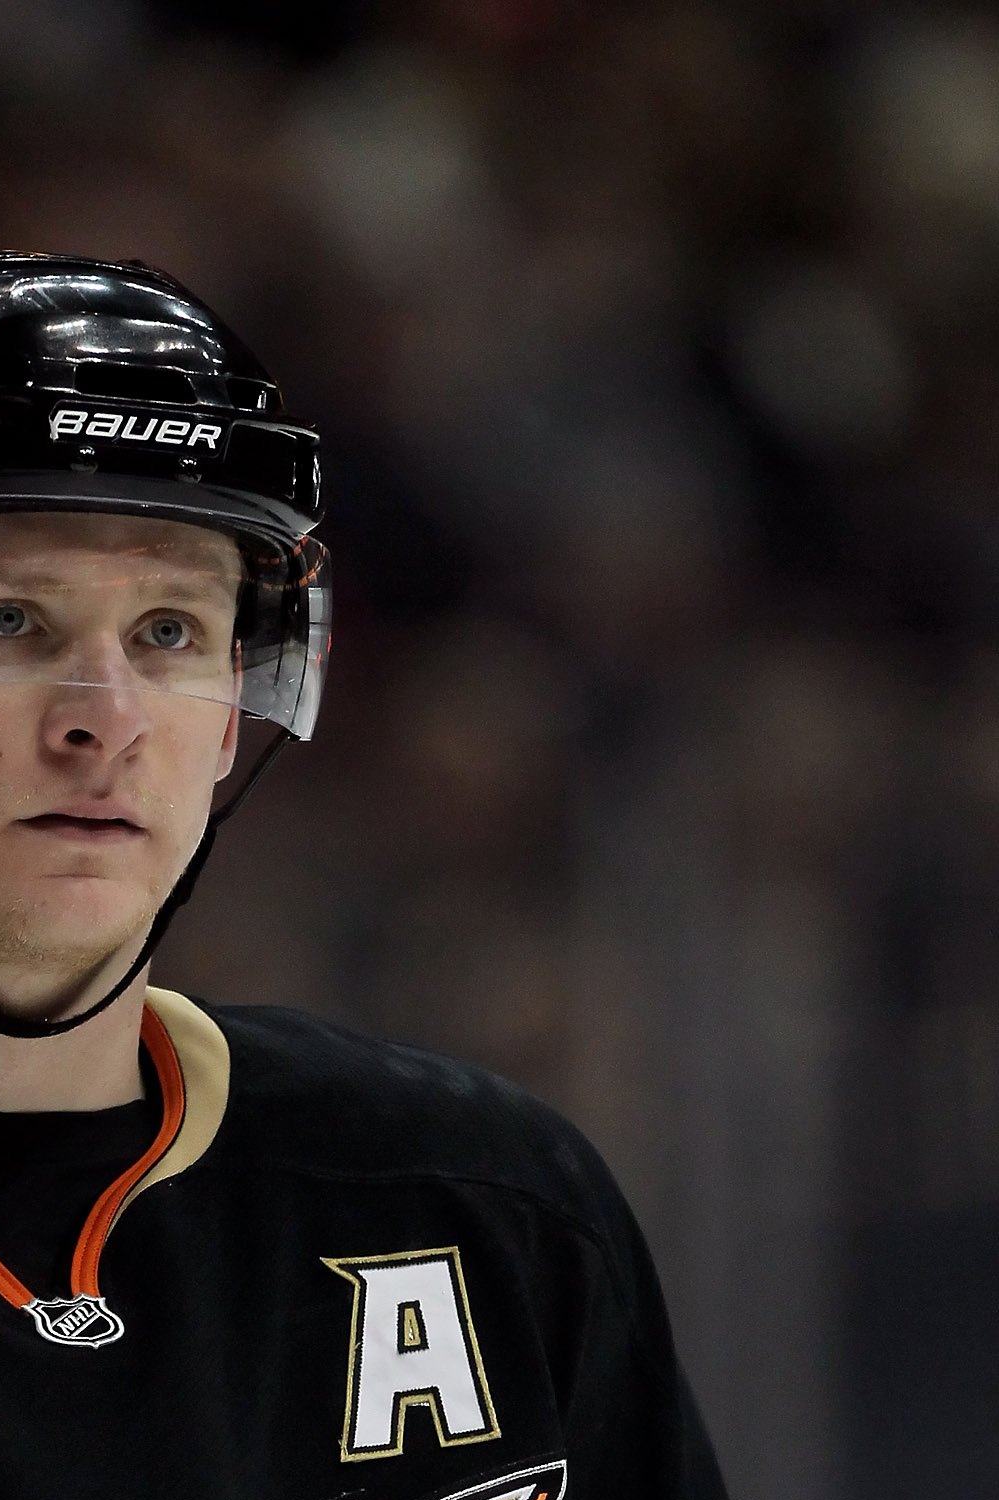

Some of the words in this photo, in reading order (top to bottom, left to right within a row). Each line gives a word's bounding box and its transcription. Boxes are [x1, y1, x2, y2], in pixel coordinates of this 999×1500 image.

[50, 410, 221, 449] BAUER
[56, 1306, 97, 1336] NHL
[320, 1246, 501, 1462] A
